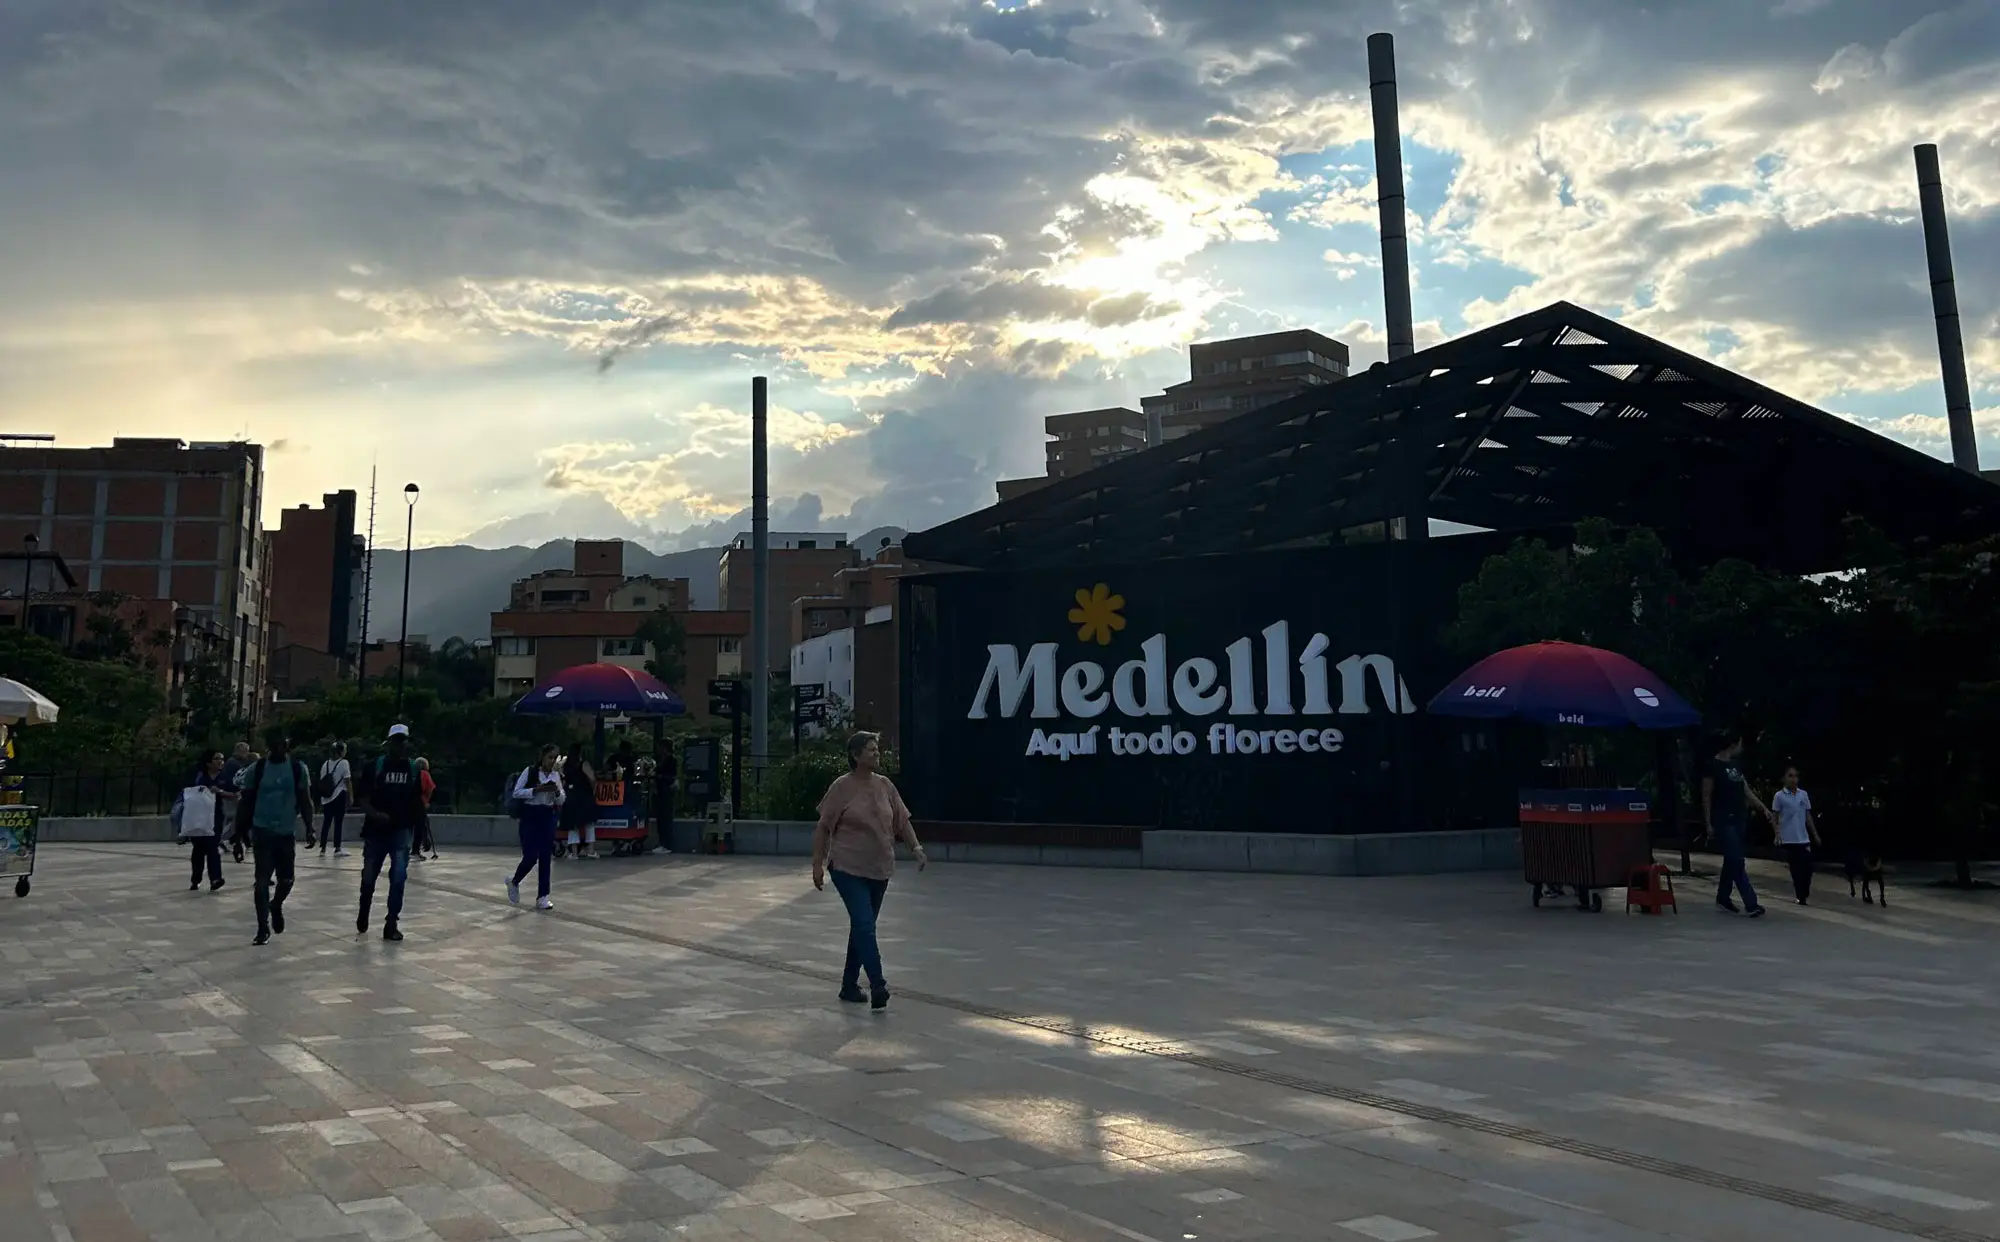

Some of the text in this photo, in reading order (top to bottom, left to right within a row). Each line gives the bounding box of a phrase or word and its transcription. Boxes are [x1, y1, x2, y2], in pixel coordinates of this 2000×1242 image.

[967, 619, 1418, 719] Medellín
[1463, 684, 1507, 698] bold
[600, 702, 617, 710] bold
[1558, 712, 1584, 724] bold
[1025, 722, 1344, 761] Aquí todo florece
